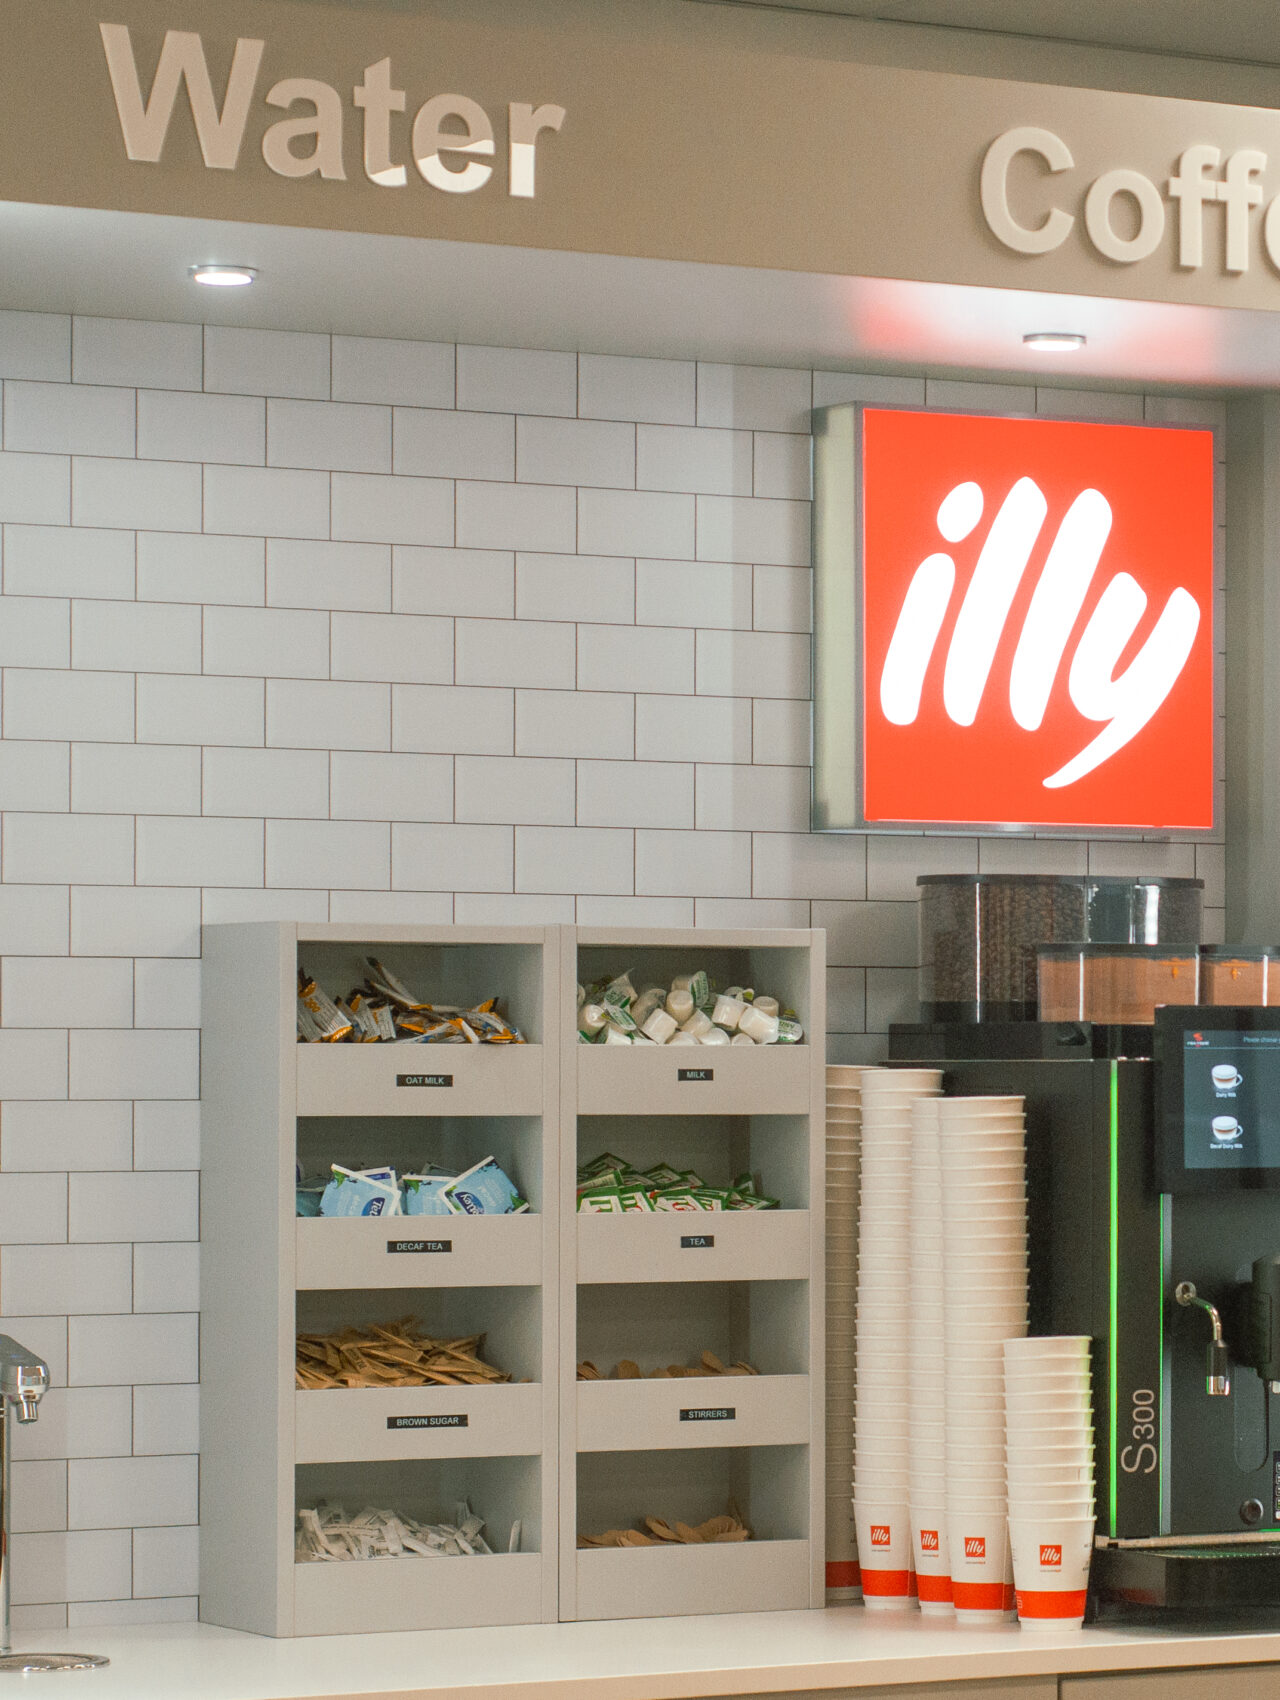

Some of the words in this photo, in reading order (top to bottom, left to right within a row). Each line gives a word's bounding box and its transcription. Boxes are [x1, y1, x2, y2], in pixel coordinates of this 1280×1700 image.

[100, 23, 566, 198] Water
[880, 476, 1201, 789] illy
[405, 1076, 423, 1084] OAT
[424, 1076, 445, 1084] MILK
[686, 1071, 706, 1079] MILK
[396, 1242, 424, 1250] DECAF
[426, 1242, 443, 1250] TEA
[690, 1237, 706, 1245] TEA
[396, 1418, 428, 1426] BROWN
[429, 1416, 459, 1425] SUGAR
[688, 1410, 728, 1418] STIRRERS
[1120, 1389, 1156, 1474] S300
[872, 1529, 889, 1544] illy
[922, 1533, 937, 1549] illy
[966, 1540, 984, 1556] illy
[1041, 1548, 1060, 1564] illy
